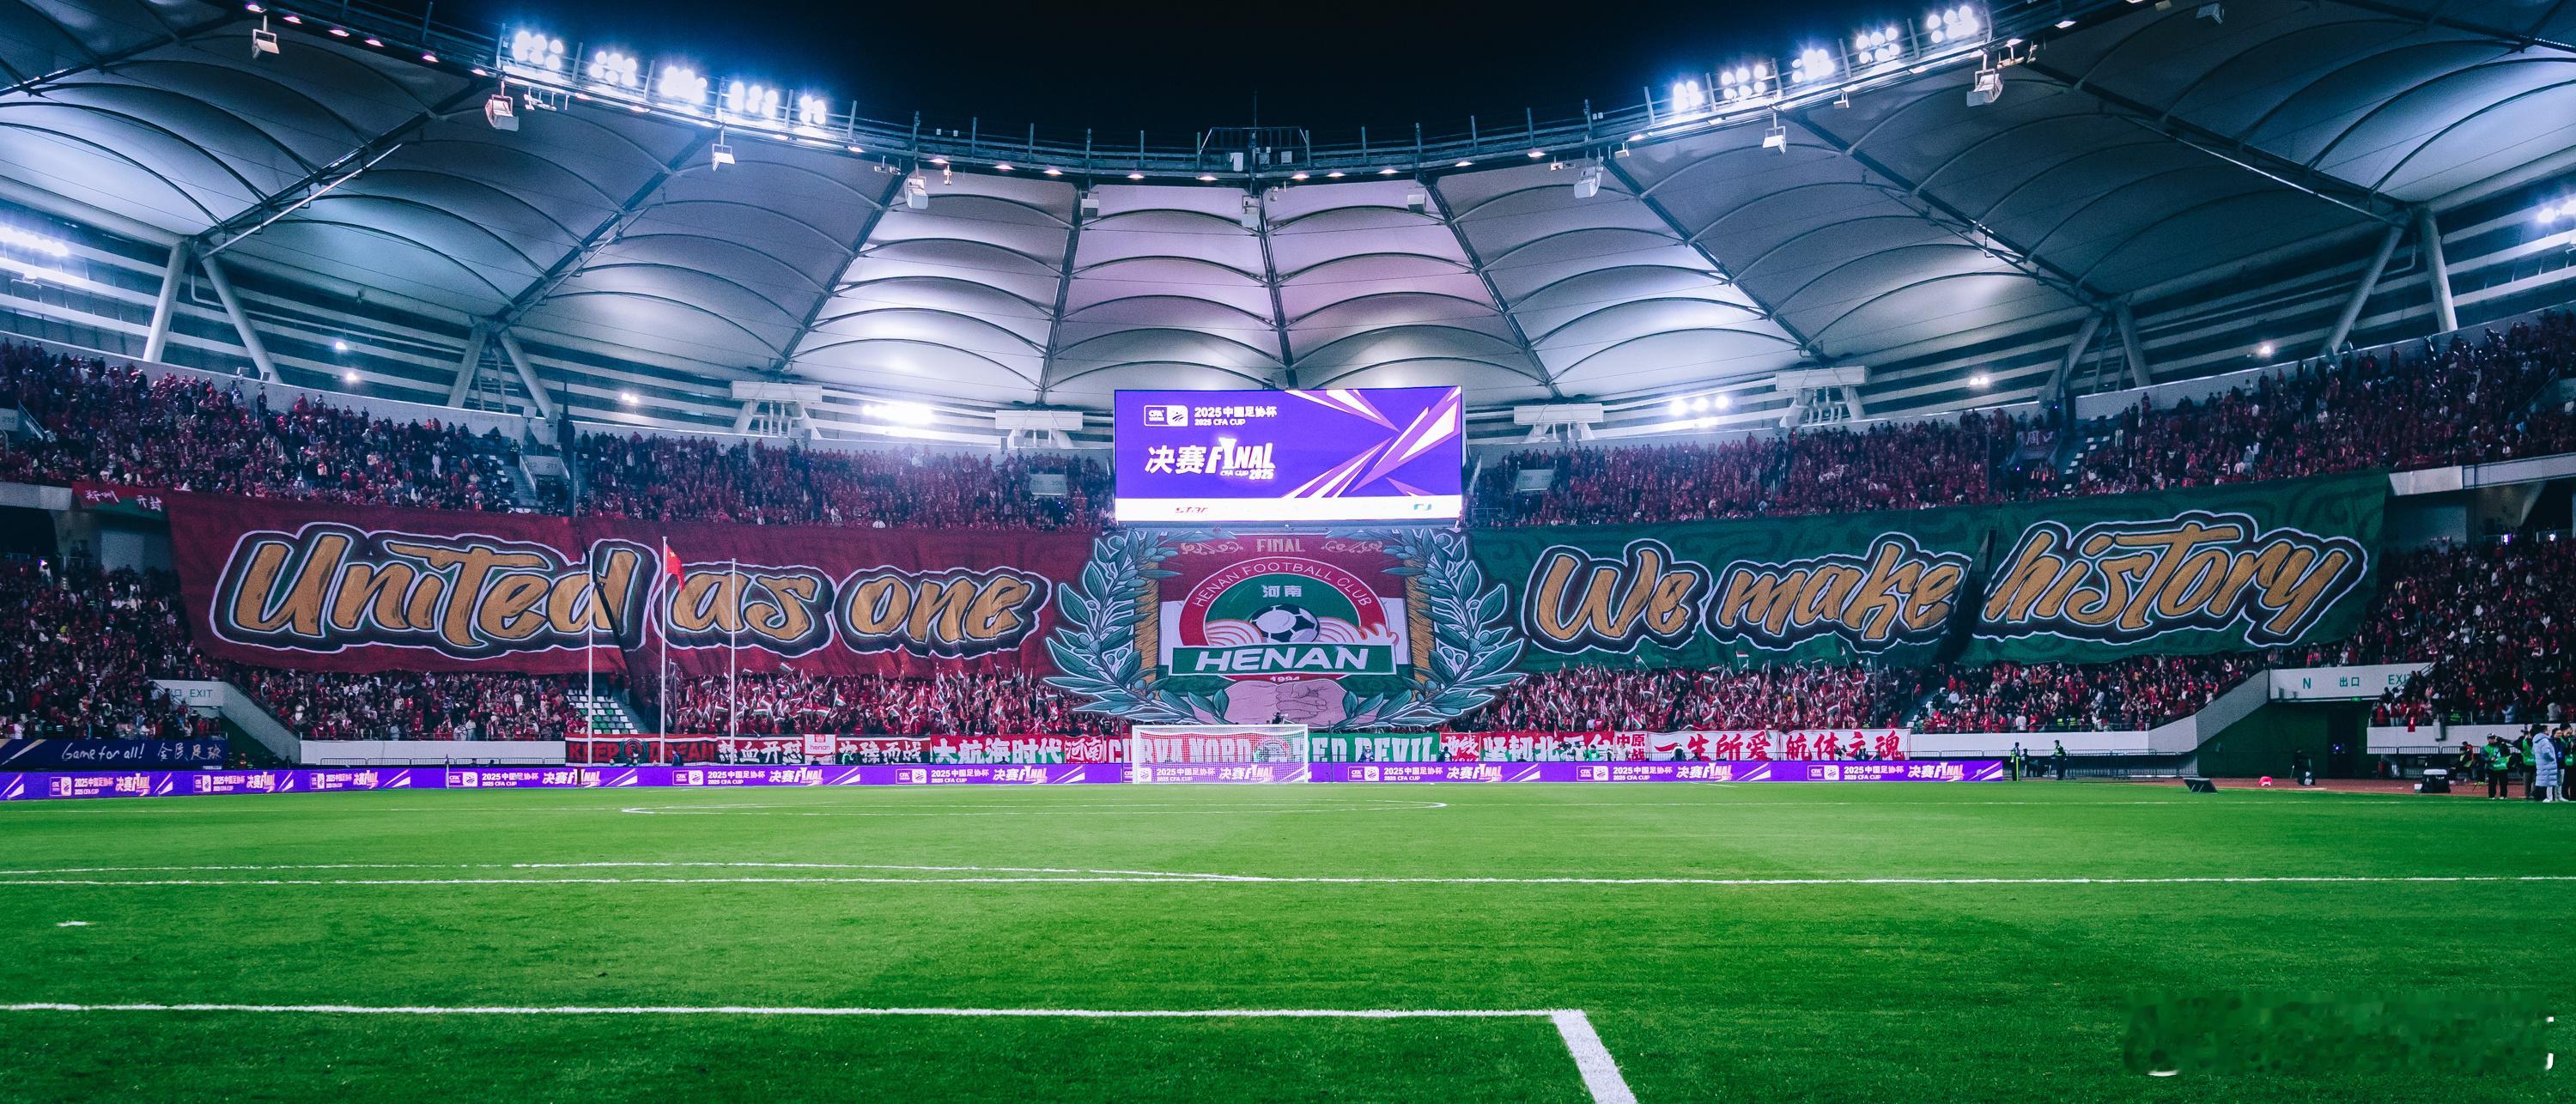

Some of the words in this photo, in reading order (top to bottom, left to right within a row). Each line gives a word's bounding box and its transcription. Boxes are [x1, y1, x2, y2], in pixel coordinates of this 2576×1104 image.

[1194, 406, 1277, 417] 2025中国足协杯
[1145, 445, 1206, 474] 决赛
[1205, 437, 1276, 474] FINAL
[1256, 538, 1305, 552] FINAL
[1192, 572, 1240, 607] HENAN
[1242, 561, 1332, 580] FOOTBALL
[1337, 577, 1372, 607] CLUB
[1531, 544, 1703, 646] We
[1715, 537, 1966, 644] make
[1979, 519, 2357, 637] history
[228, 528, 646, 652] United
[665, 567, 824, 648] as
[844, 570, 1039, 647] one
[1262, 585, 1302, 598] 河南
[1194, 648, 1370, 671] HENAN
[2302, 677, 2312, 689] N
[2339, 676, 2360, 687] 出口
[190, 689, 213, 698] EXIT
[62, 742, 95, 761] Game
[99, 745, 119, 762] for
[124, 743, 145, 759] all!
[933, 737, 1063, 764] 大航海时代
[1065, 737, 1103, 761] 河南
[1655, 730, 1773, 761] 一生所爱
[708, 770, 765, 779] 2025中国足协杯
[769, 769, 794, 783] 决赛
[794, 767, 823, 783] FINAL
[932, 769, 989, 778] 2025中国足协杯
[993, 768, 1018, 781] 决赛
[1018, 765, 1048, 781] FINAL
[1219, 767, 1245, 779] 决赛
[1384, 767, 1443, 775] 2025中国足协杯
[1447, 766, 1473, 779] 决赛
[1472, 763, 1503, 779] FINAL
[1613, 766, 1673, 774] 2025中国足协杯
[1676, 765, 1703, 779] 决赛
[1844, 765, 1904, 773] 2025中国足协杯
[1907, 764, 1935, 779] 决赛
[543, 771, 568, 784] 决赛
